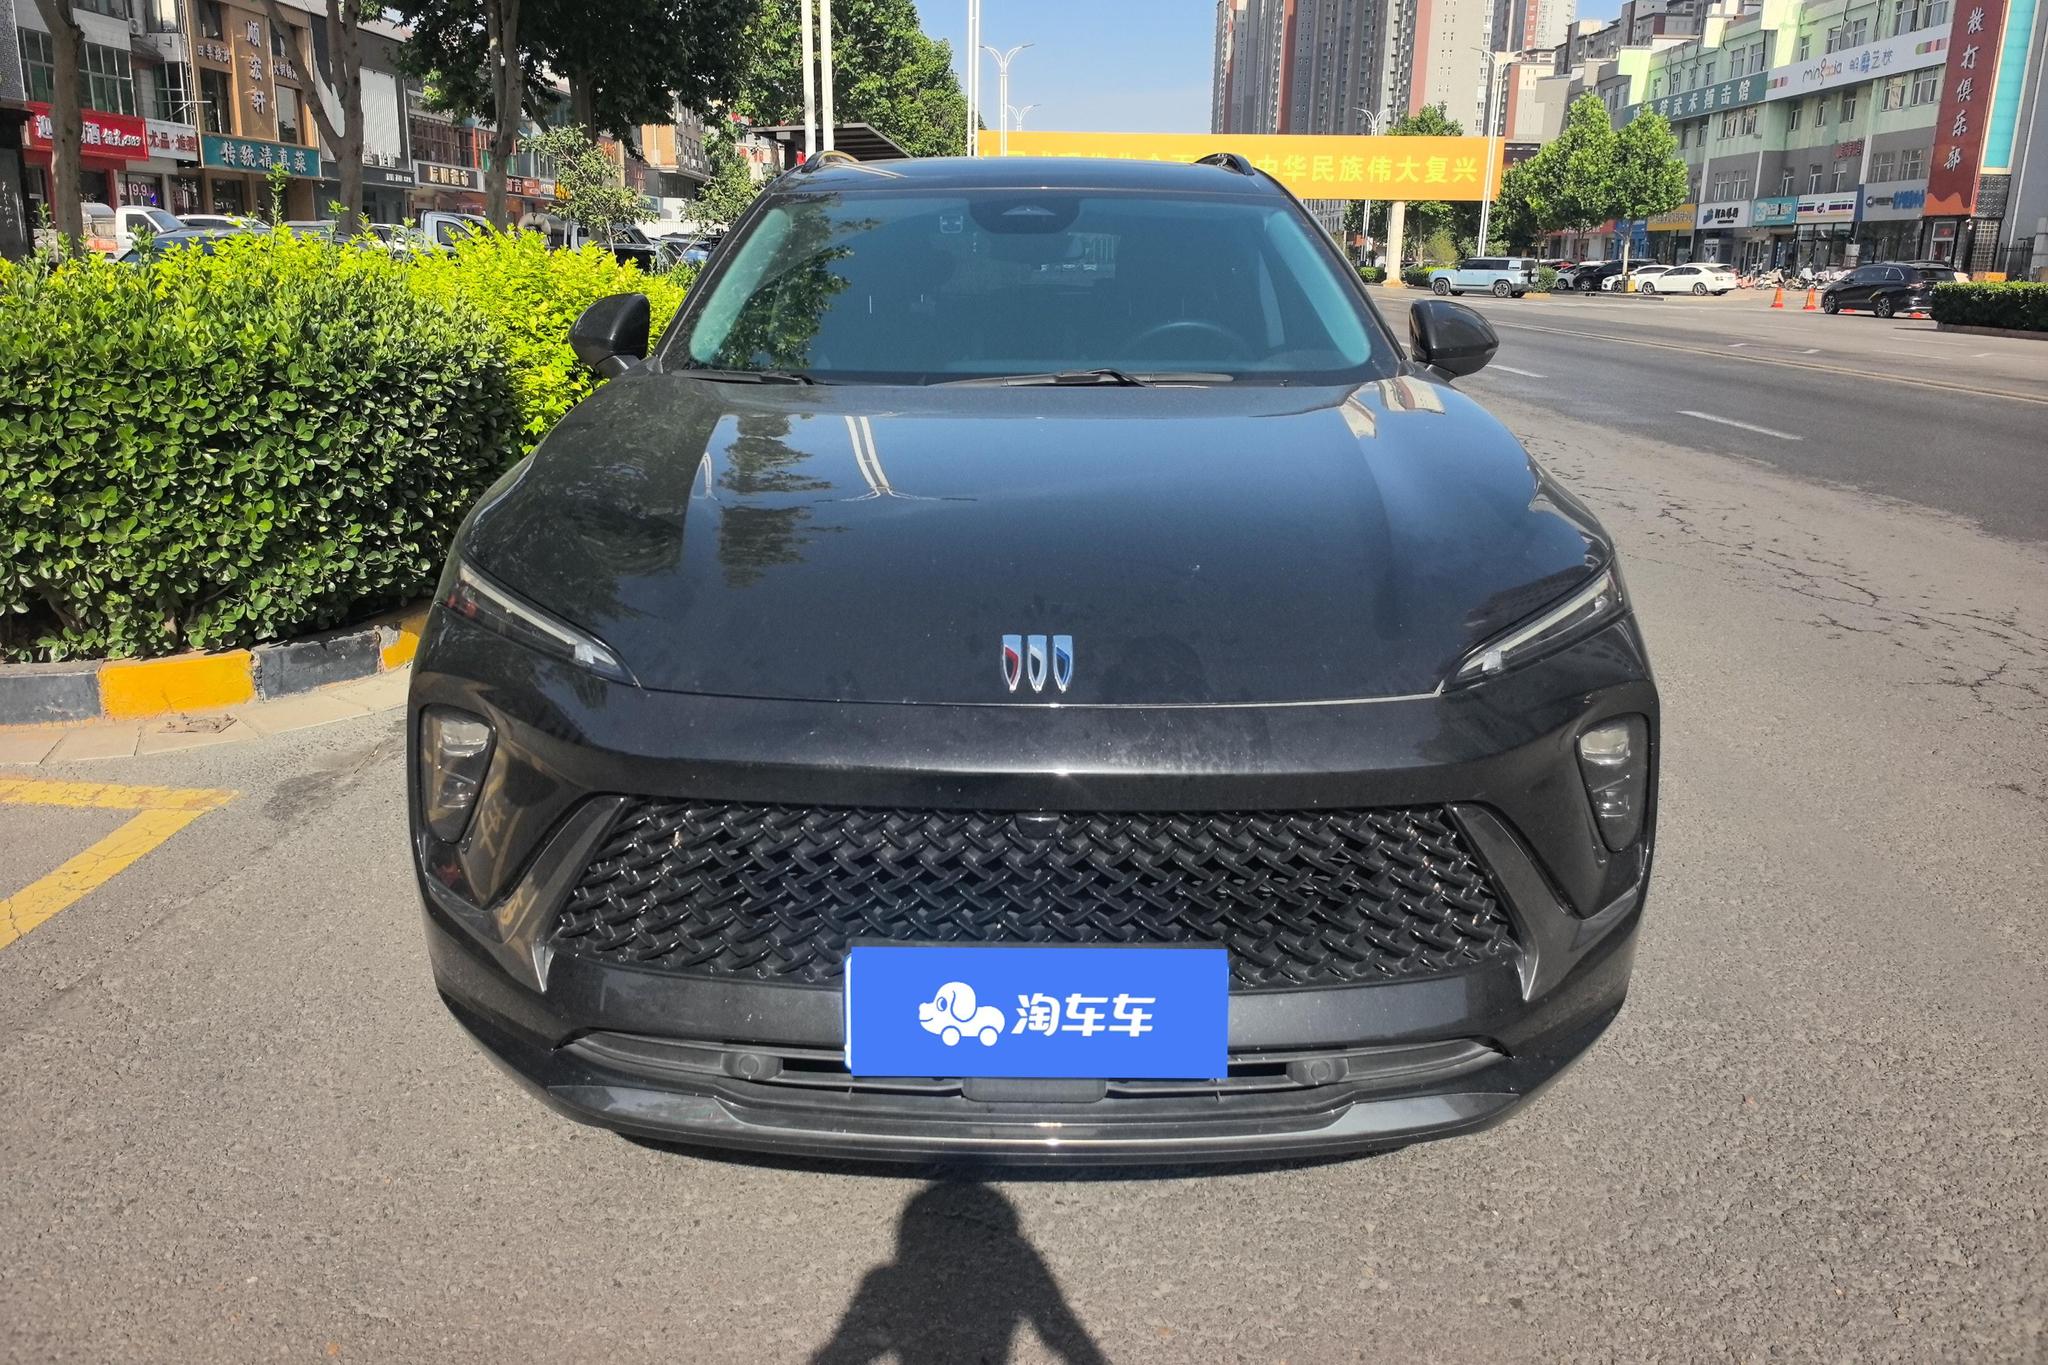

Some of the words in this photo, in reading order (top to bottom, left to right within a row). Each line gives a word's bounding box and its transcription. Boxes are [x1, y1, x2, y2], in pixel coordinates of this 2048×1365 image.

[1943, 7, 1985, 172] 散打俱乐部
[220, 141, 307, 174] 传统清真菜
